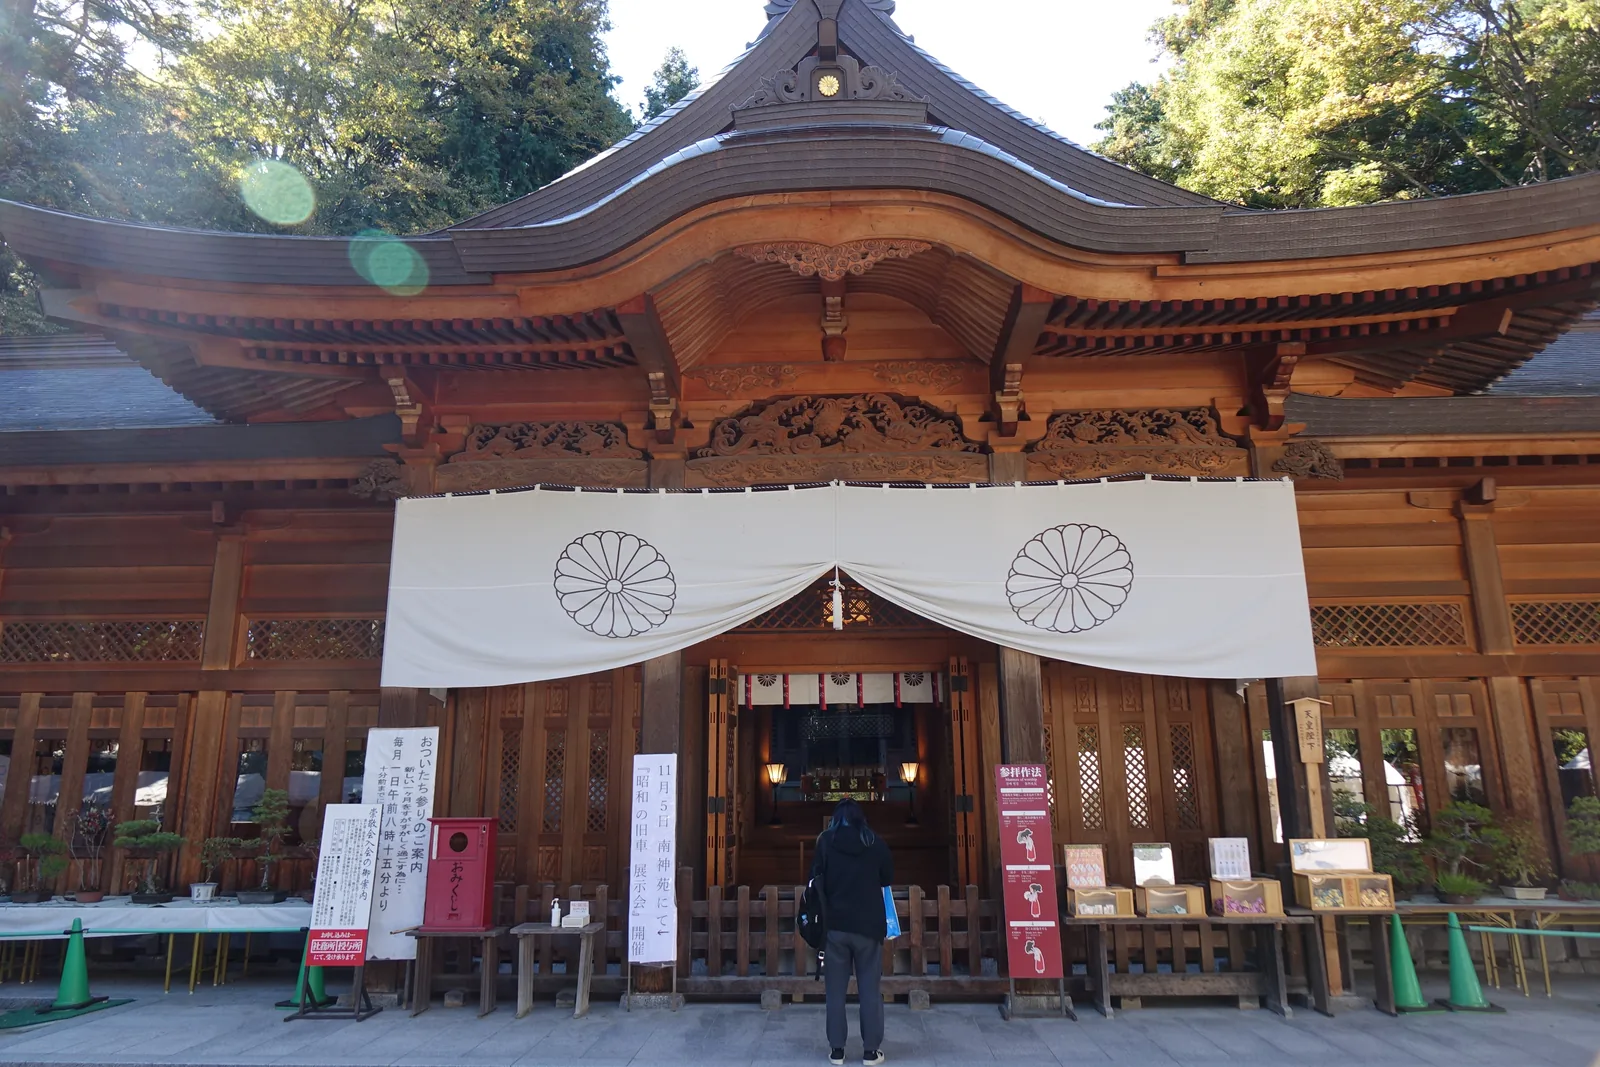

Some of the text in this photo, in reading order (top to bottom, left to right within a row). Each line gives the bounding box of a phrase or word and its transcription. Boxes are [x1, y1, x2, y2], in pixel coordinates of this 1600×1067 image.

[1304, 709, 1316, 751] 天皇陛下
[1000, 767, 1042, 777] 参拝作法
[379, 736, 404, 912] 毎月一日午前八時十五分より
[410, 736, 433, 873] おついたち参りのご案内
[359, 807, 378, 901] 崇敬会入会の御案内
[450, 861, 464, 911] おみくじ
[312, 941, 361, 951] 社務所 授与所
